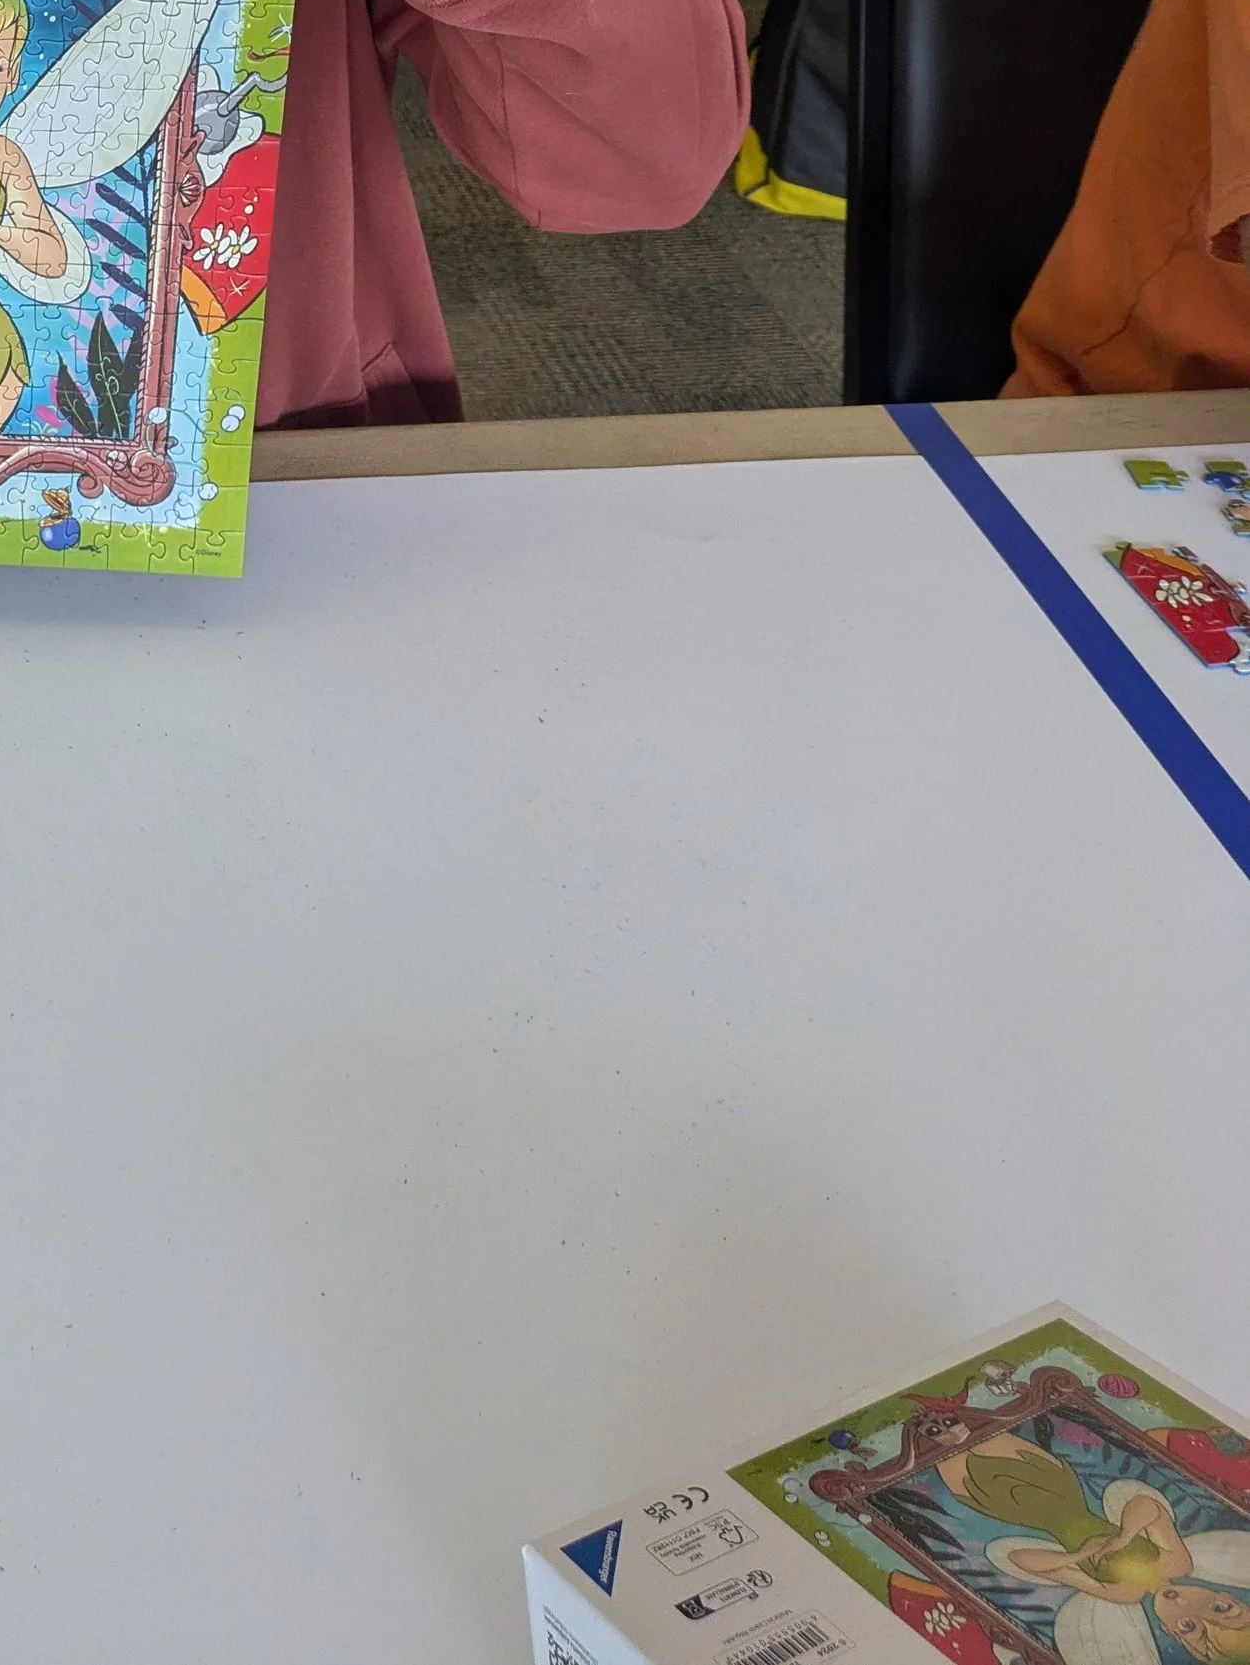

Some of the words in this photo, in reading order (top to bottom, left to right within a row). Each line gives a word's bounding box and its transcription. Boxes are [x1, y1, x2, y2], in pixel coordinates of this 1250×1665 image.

[643, 1501, 668, 1516] CA
[657, 1508, 678, 1524] UK
[598, 1530, 618, 1584] Ravensburger
